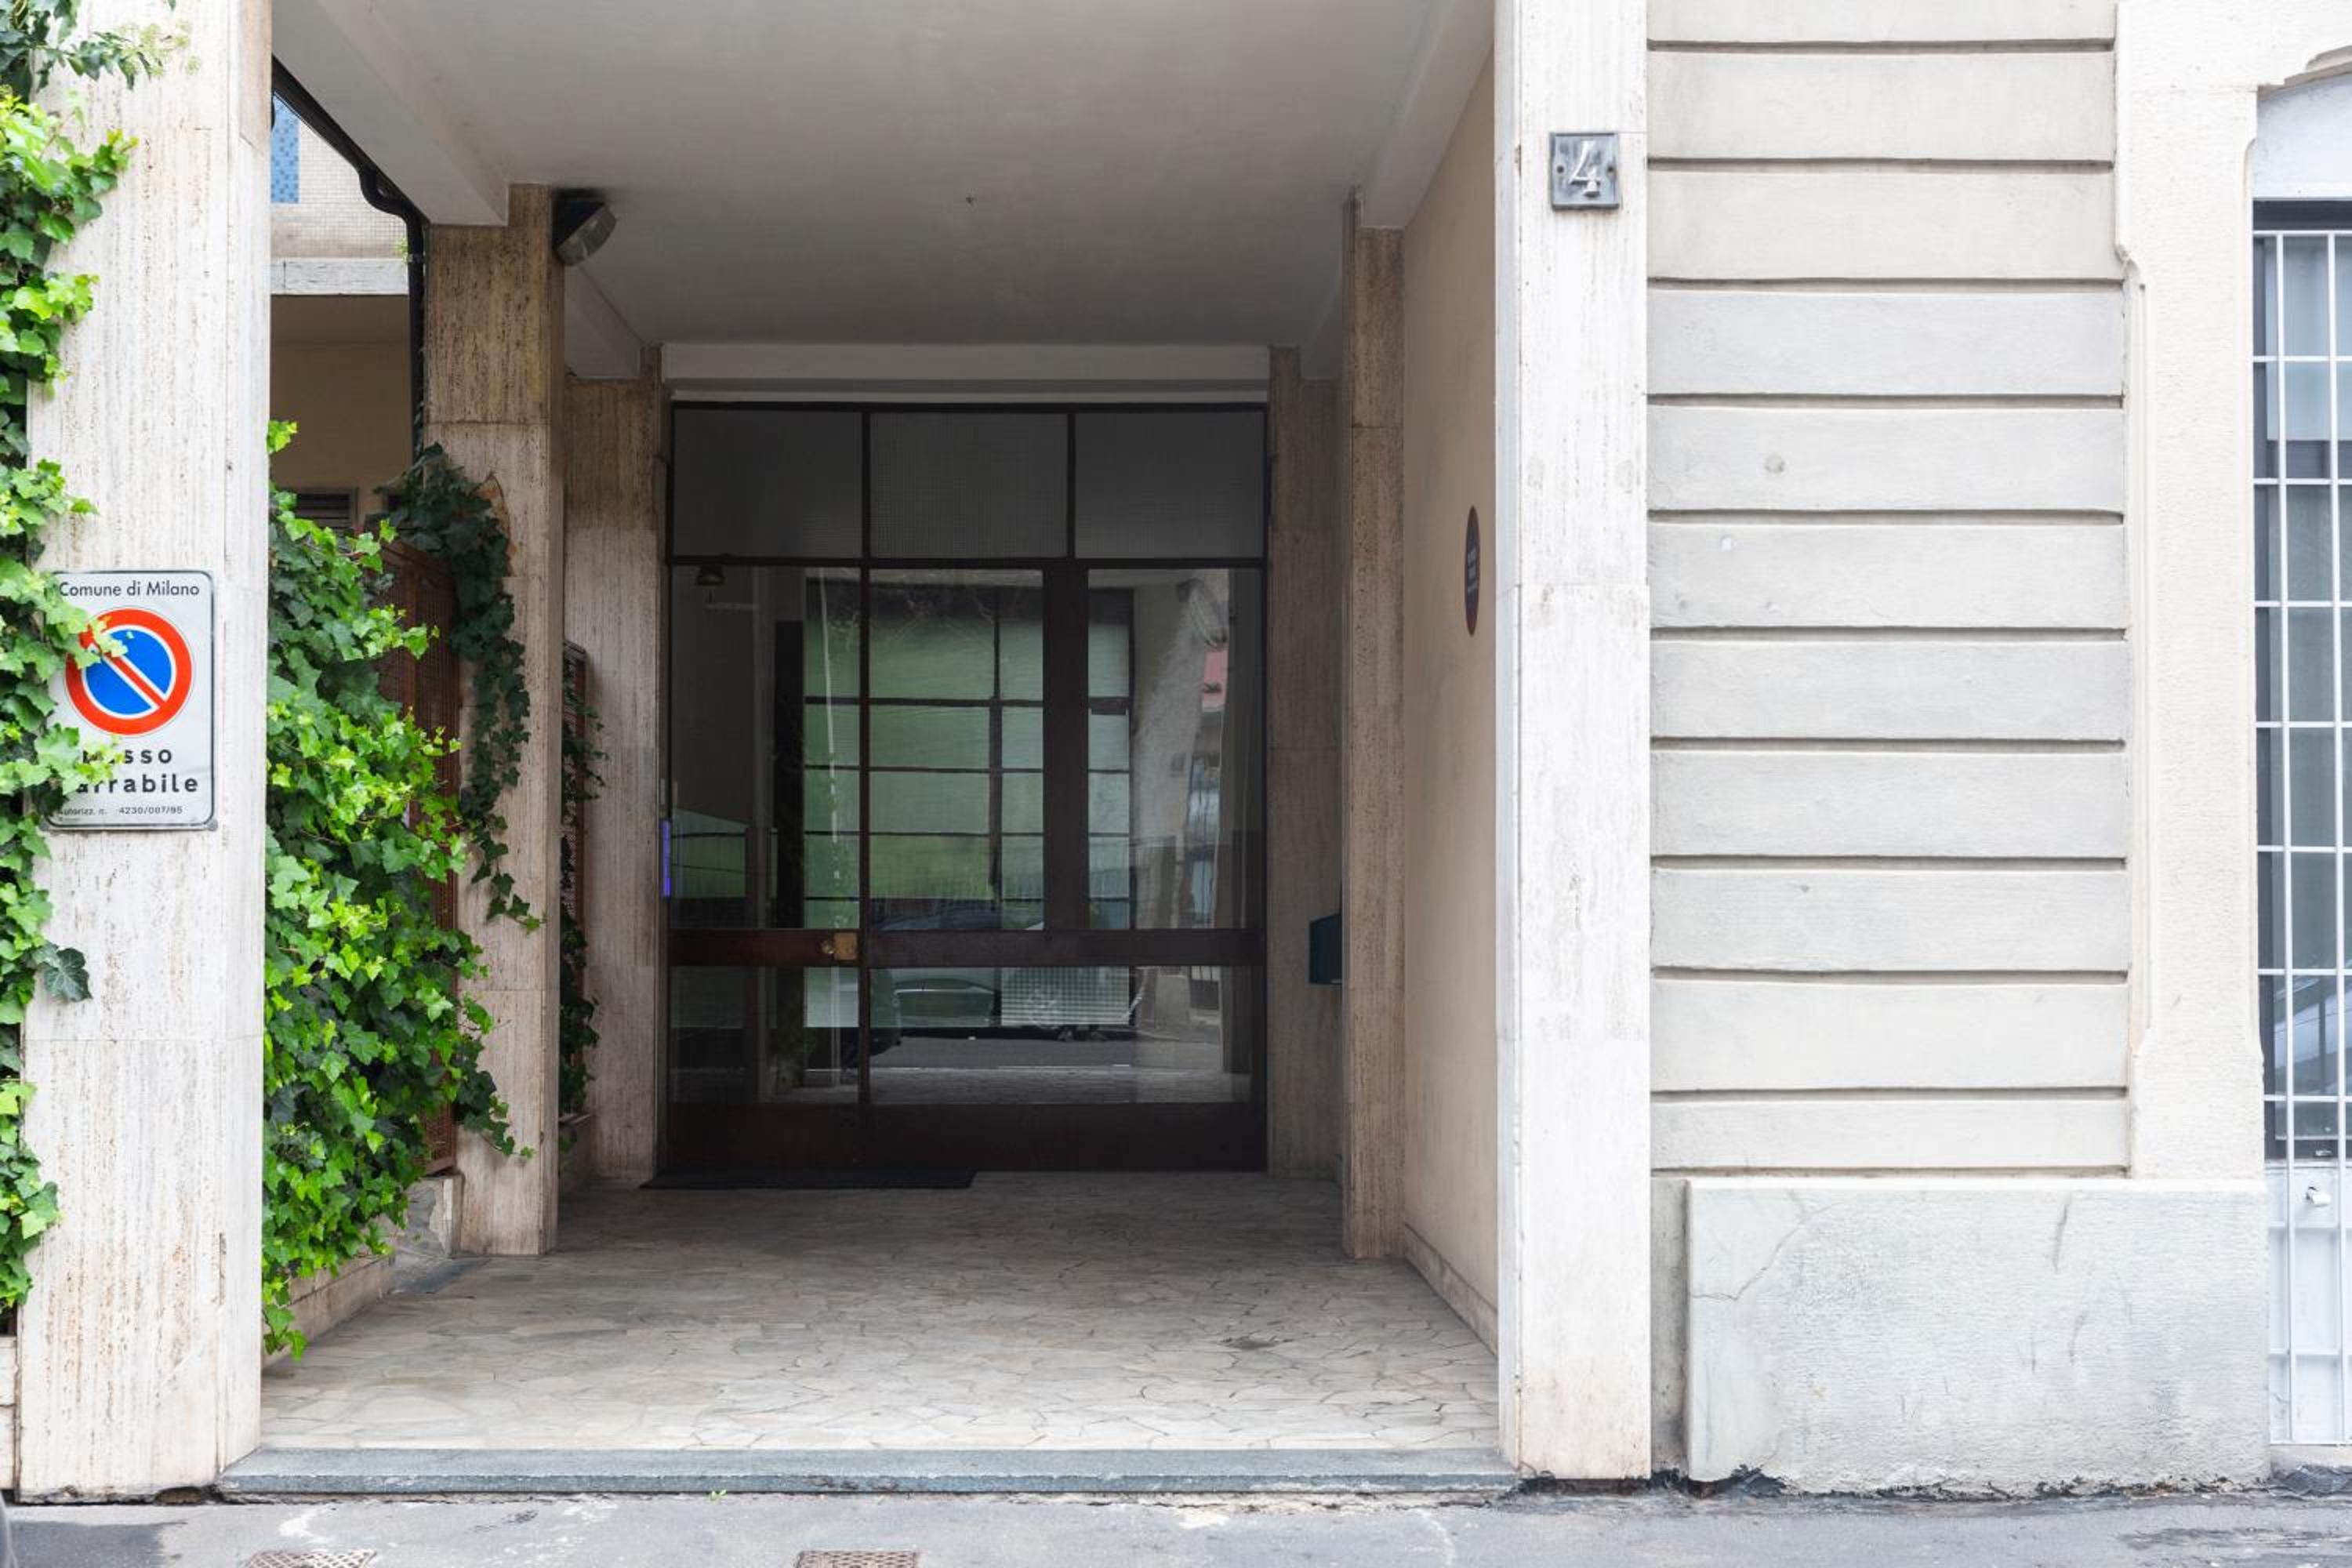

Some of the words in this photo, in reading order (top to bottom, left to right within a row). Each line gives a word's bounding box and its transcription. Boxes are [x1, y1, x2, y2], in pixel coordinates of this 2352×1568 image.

[1568, 140, 1602, 197] 4
[58, 581, 122, 597] Comune
[126, 580, 140, 596] di
[146, 580, 201, 596] Milano
[82, 749, 172, 764] sso
[75, 773, 198, 793] arrabile
